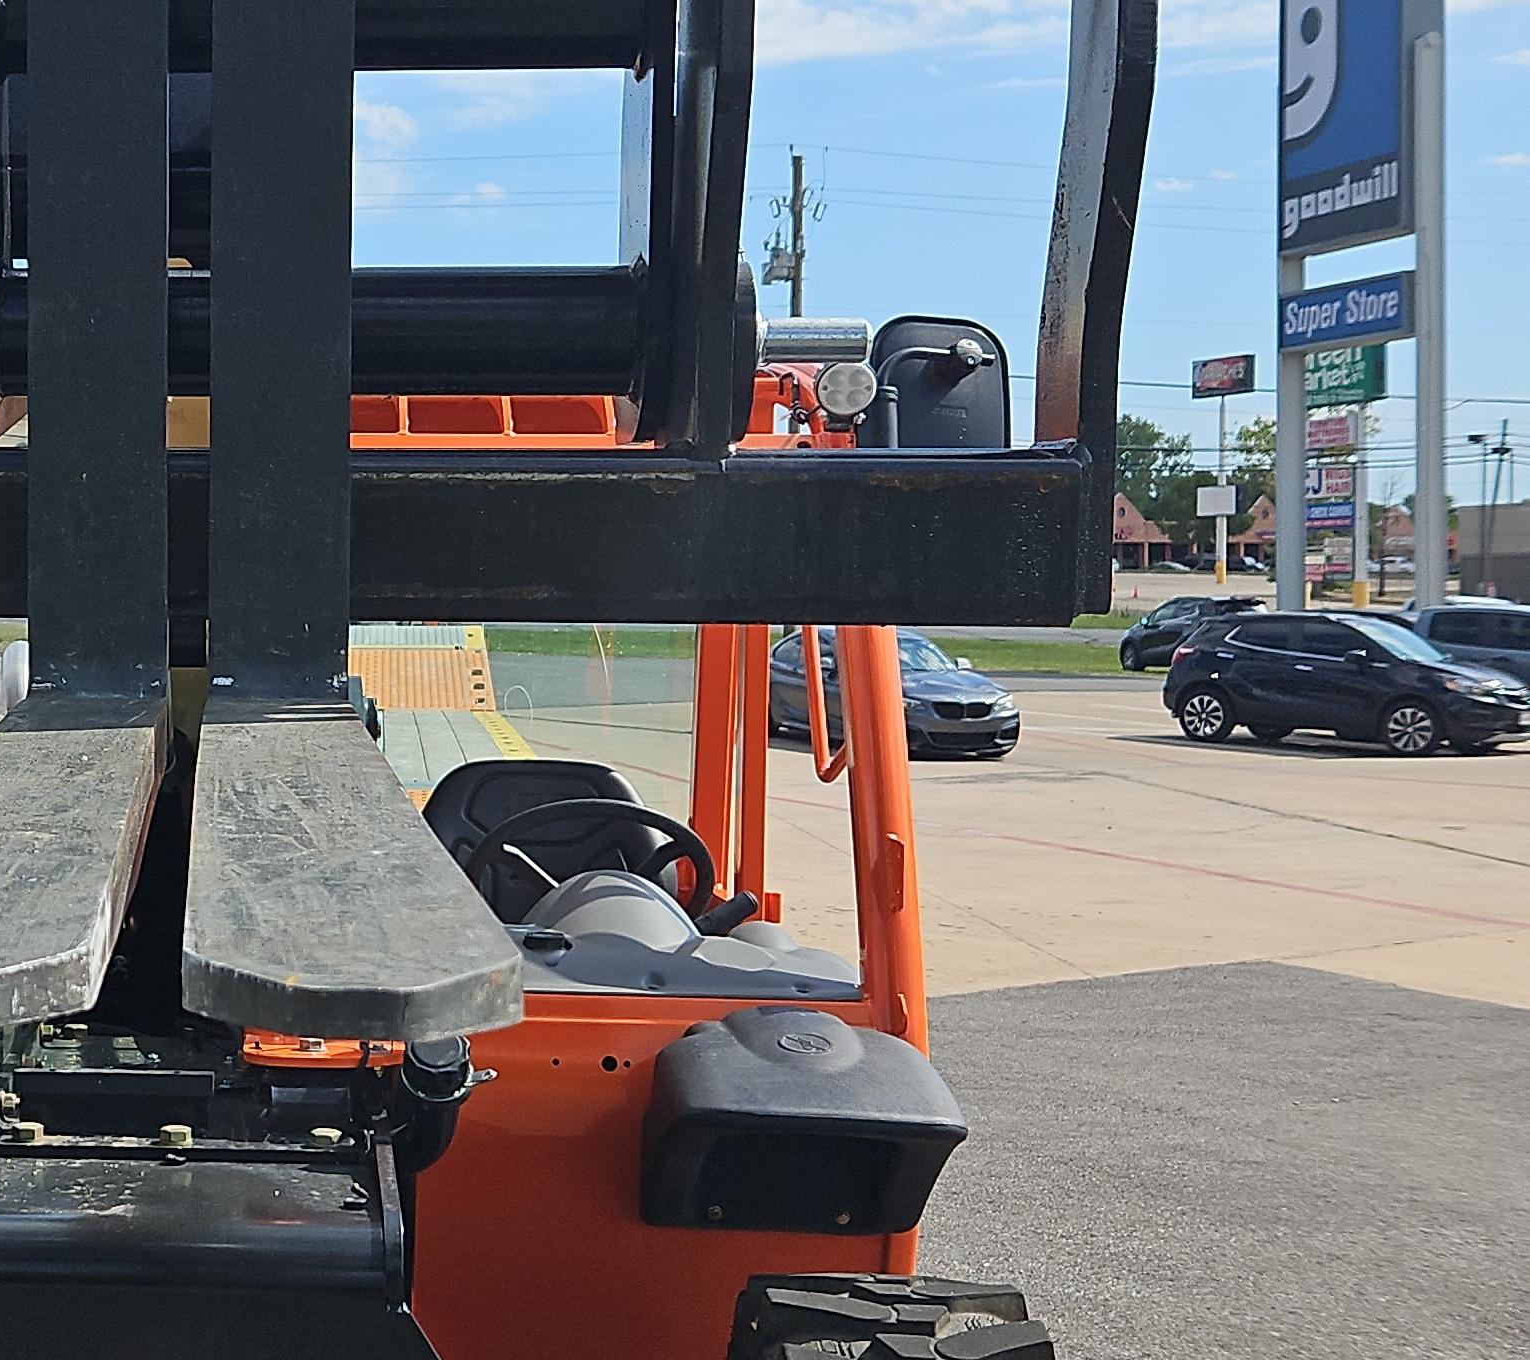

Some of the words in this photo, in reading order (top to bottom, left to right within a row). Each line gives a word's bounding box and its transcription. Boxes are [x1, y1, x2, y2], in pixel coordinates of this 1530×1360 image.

[1282, 160, 1399, 239] goodwill
[1284, 300, 1341, 339] Super
[1345, 289, 1399, 324] Store
[1305, 346, 1363, 371] reen
